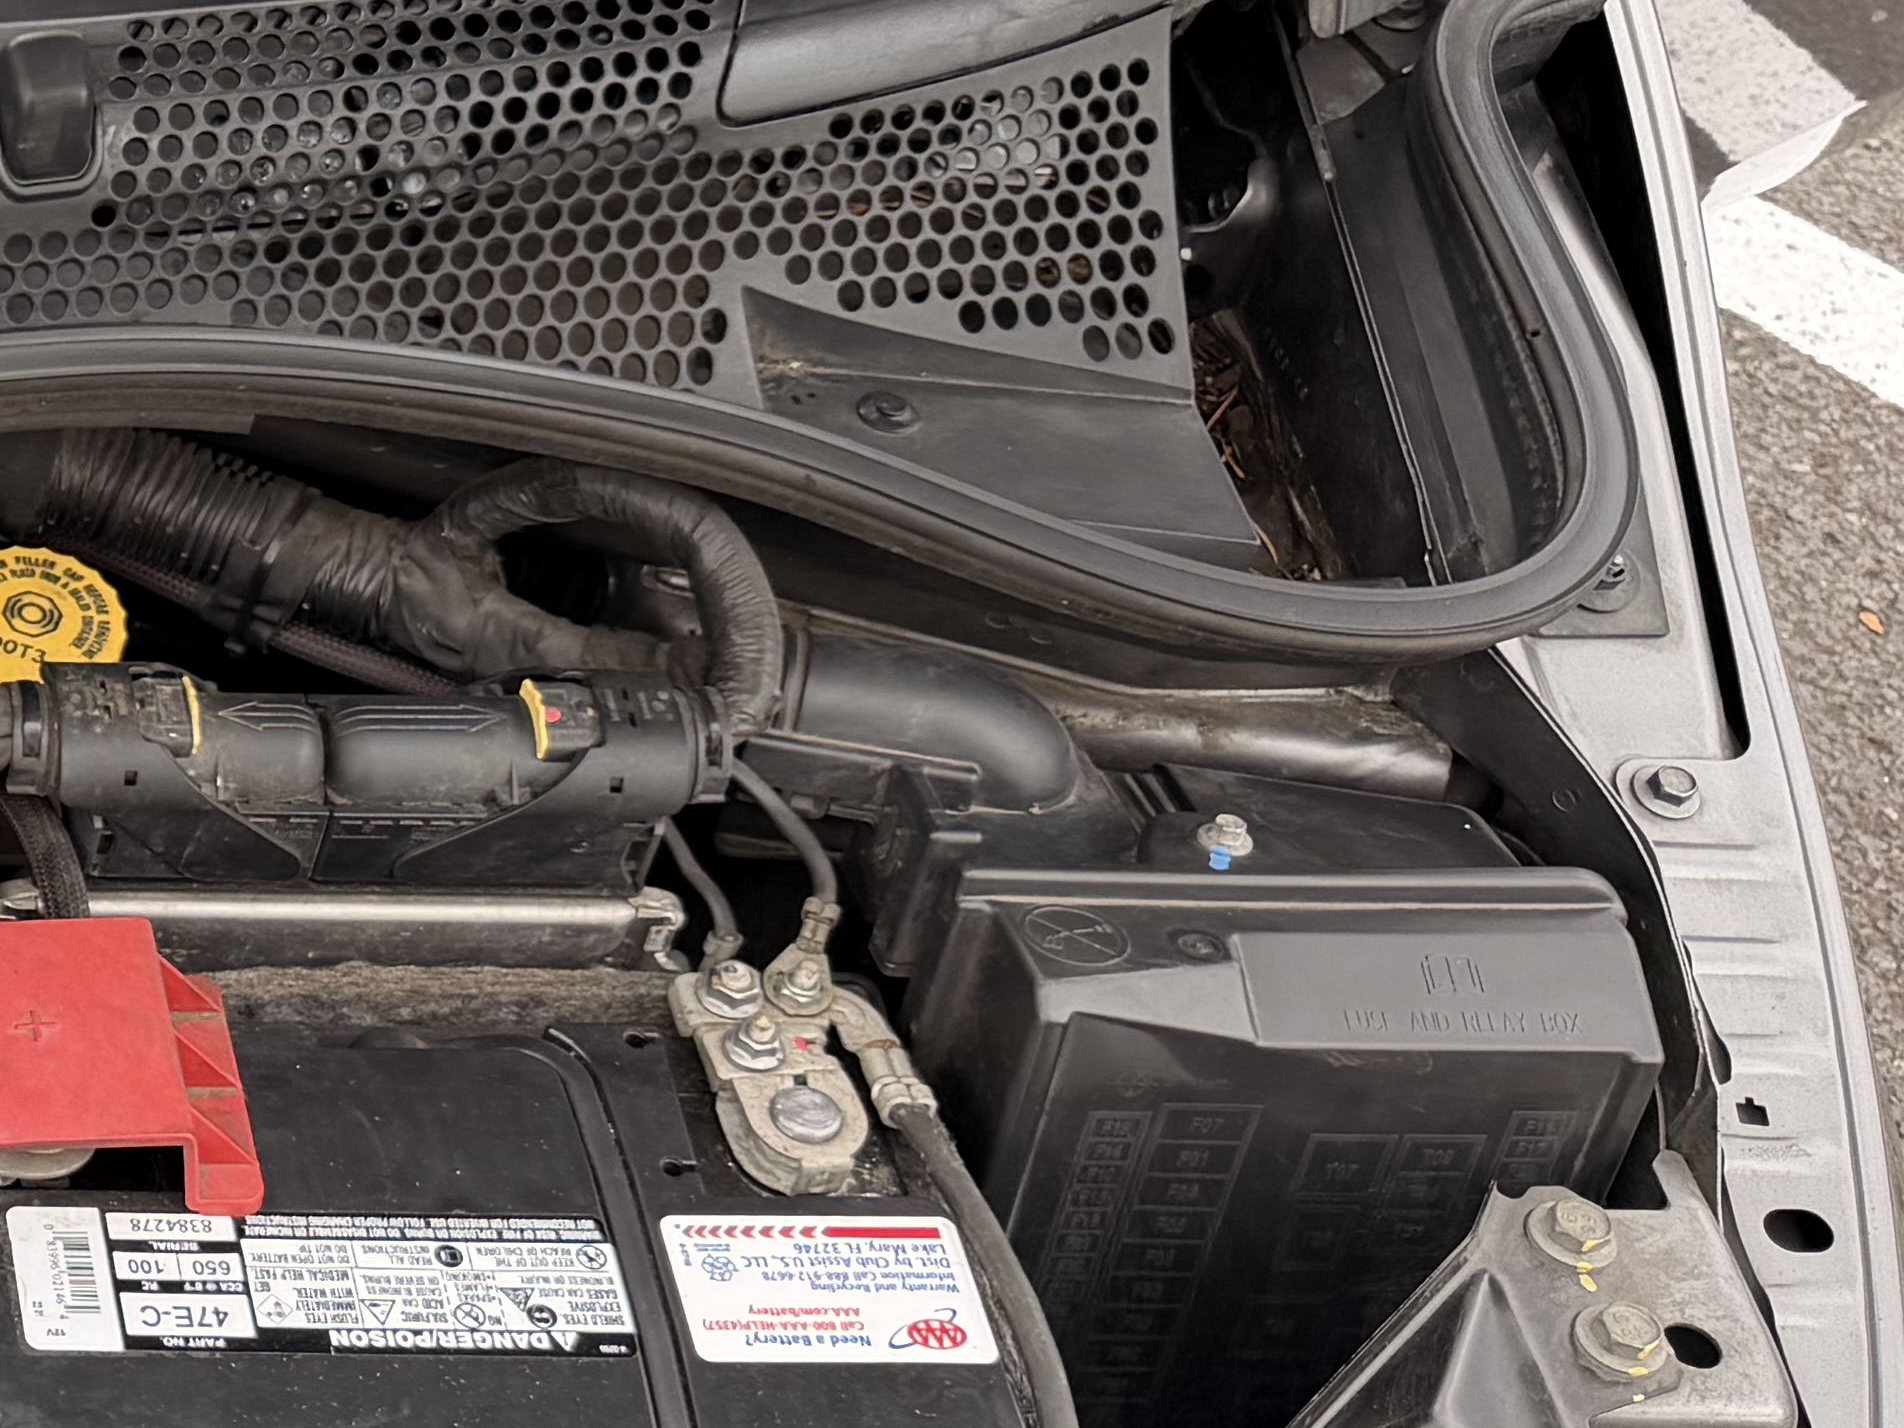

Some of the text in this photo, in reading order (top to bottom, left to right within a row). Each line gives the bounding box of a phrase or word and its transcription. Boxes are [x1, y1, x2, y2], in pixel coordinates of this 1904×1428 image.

[1411, 1011, 1451, 1032] AND
[1462, 1012, 1525, 1033] RELAY
[1541, 1012, 1582, 1034] BOX
[129, 1218, 212, 1234] 8384278
[793, 1240, 945, 1254] Lake Mary, FL 32746
[128, 1259, 164, 1274] 100
[741, 1256, 768, 1267] LLC
[810, 1256, 852, 1267] Assist
[856, 1256, 889, 1268] Club
[895, 1253, 912, 1267] by
[917, 1256, 950, 1269] Dist.
[193, 1260, 230, 1275] 650
[281, 1270, 303, 1280] HELP
[306, 1270, 349, 1280] MEDICAL
[853, 1271, 876, 1281] Call
[880, 1271, 955, 1281] Information
[811, 1280, 959, 1293] Warranty and Recycling
[140, 1305, 228, 1328] 47E-C
[748, 1305, 860, 1316] AAA.com/battery
[488, 1316, 501, 1326] NO
[840, 1321, 865, 1331] Call
[329, 1329, 549, 1349] DANGER/POISON
[745, 1332, 871, 1347] Need a Battery?
[910, 1321, 961, 1347] AAA
[187, 1337, 225, 1347] PART
